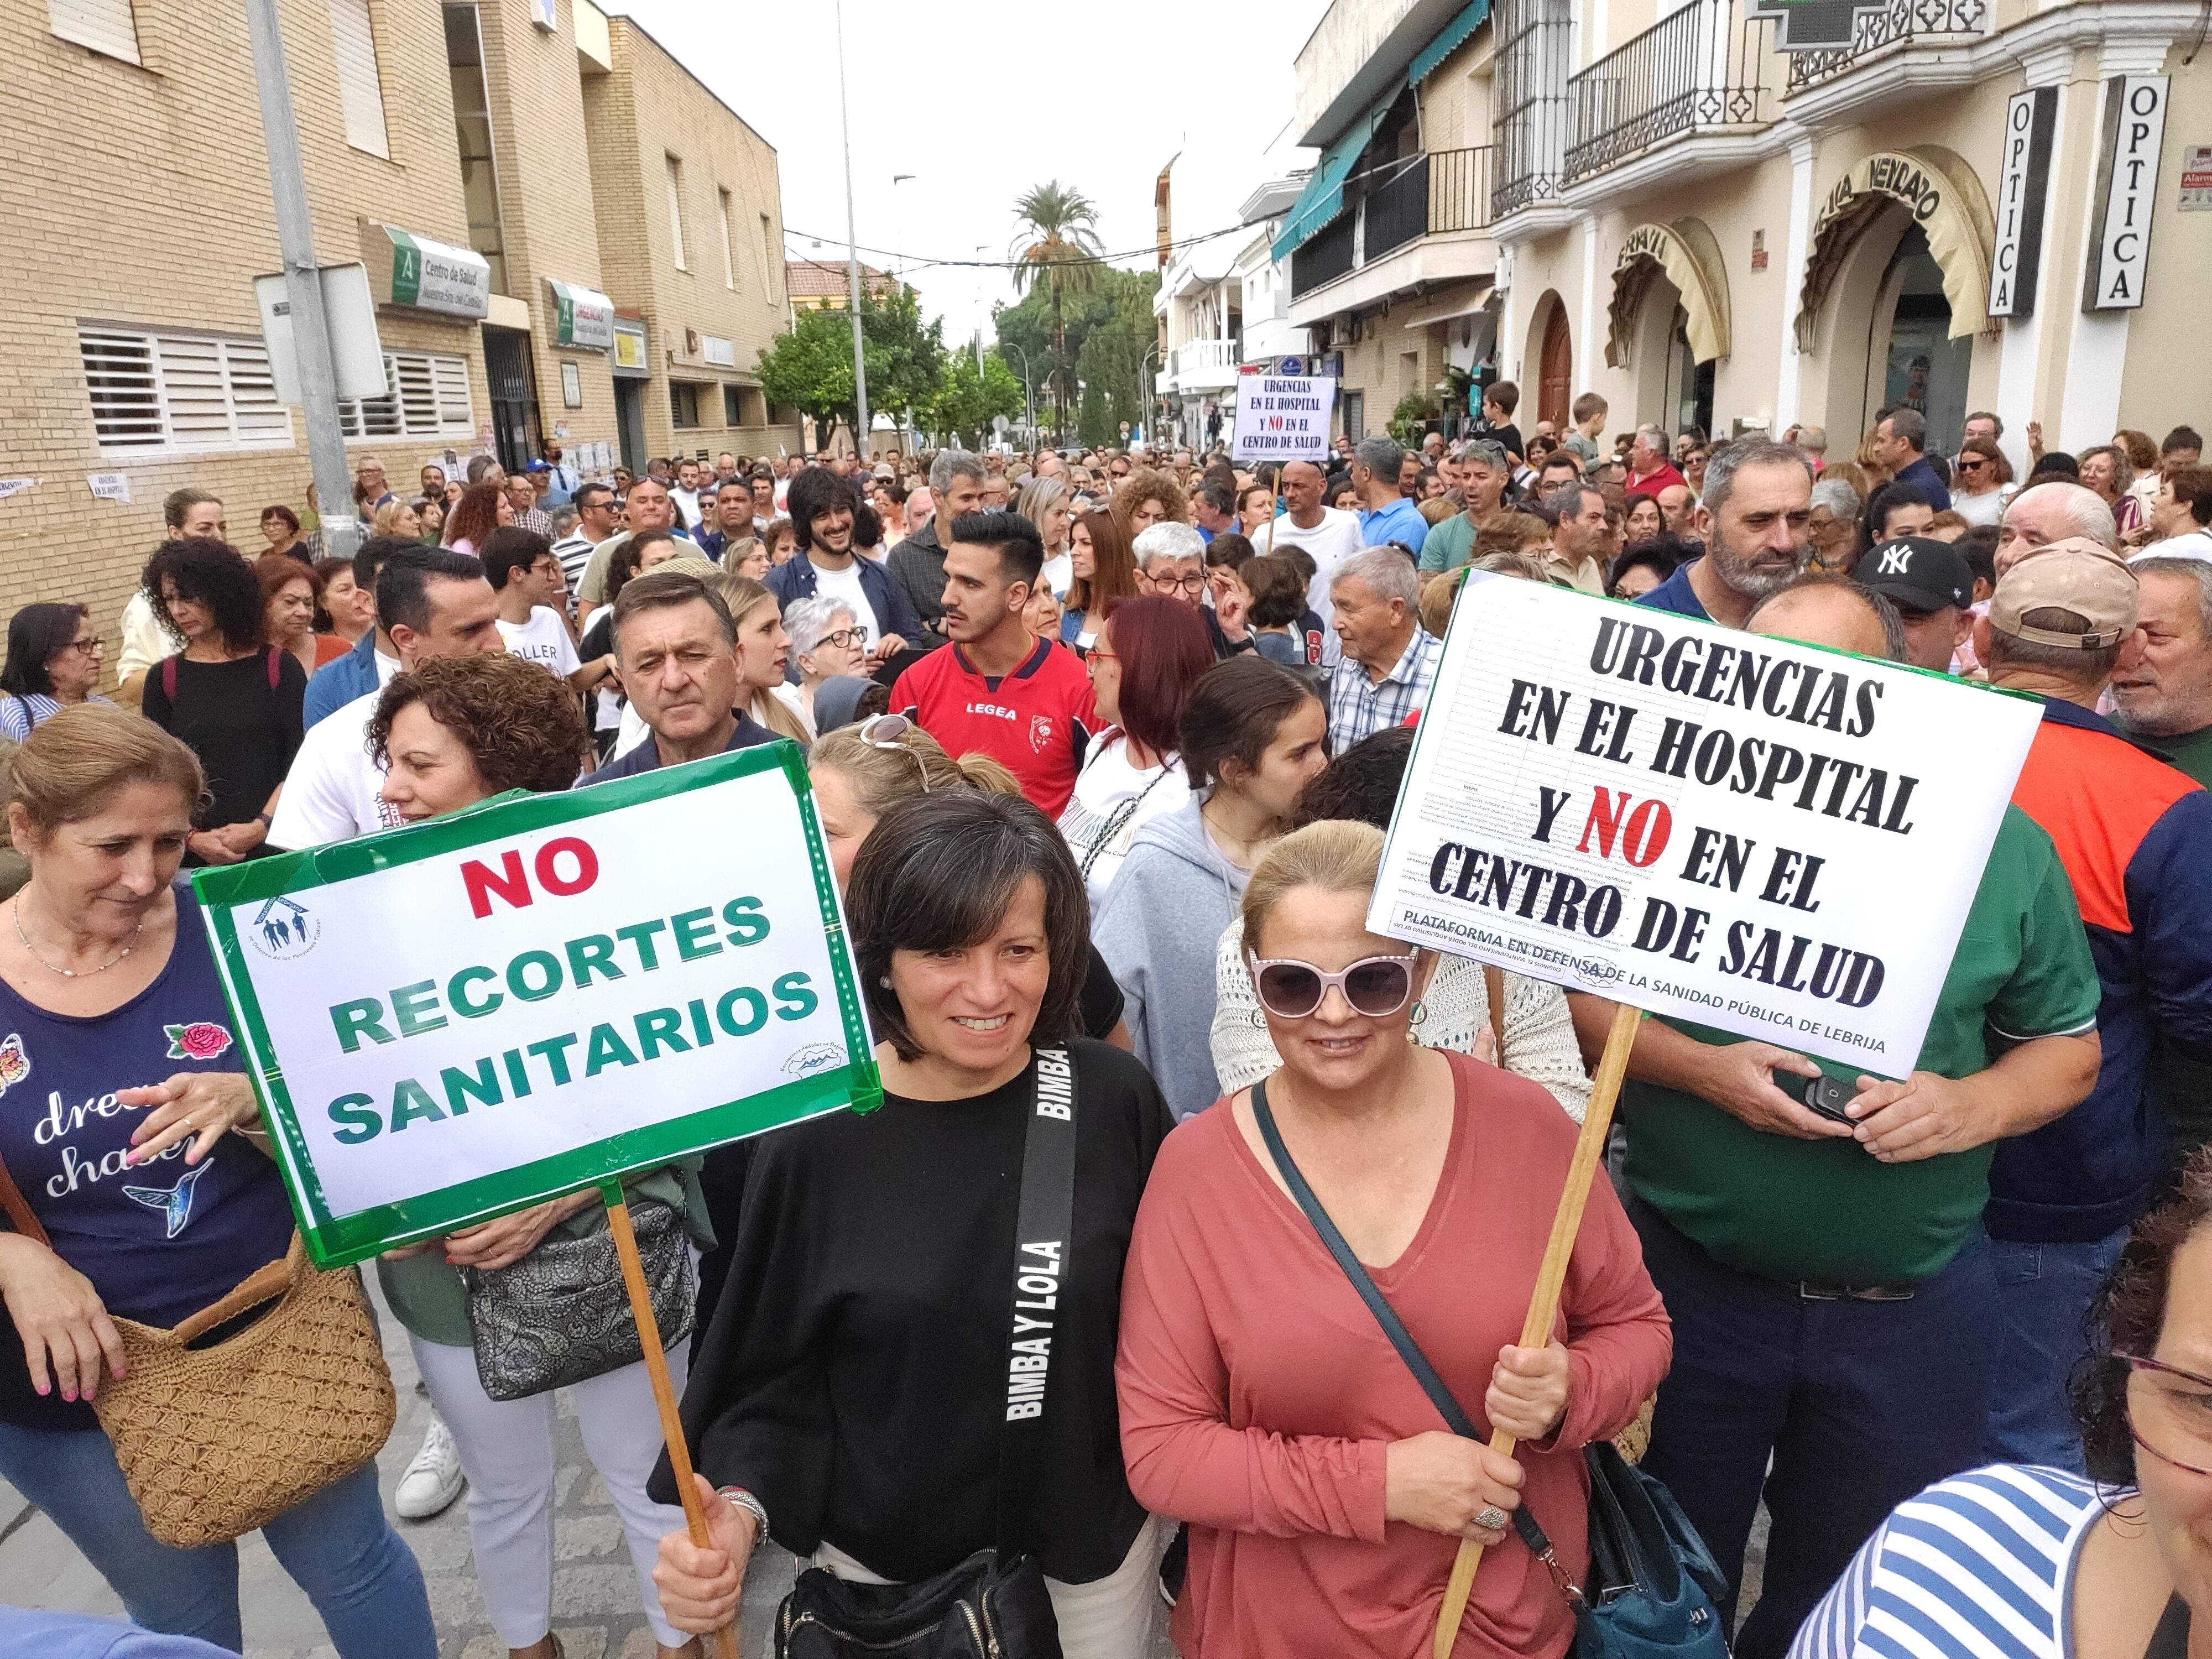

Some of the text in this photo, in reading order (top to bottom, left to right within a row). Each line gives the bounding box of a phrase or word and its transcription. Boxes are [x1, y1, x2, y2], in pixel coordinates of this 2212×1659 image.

[1996, 103, 2030, 307] OPTICA
[2109, 86, 2157, 299] OPTICA
[425, 259, 477, 285] Centro de Salud
[1243, 436, 1321, 448] CENTRO DE SALUD
[1250, 397, 1321, 410] EN EL HOSPITAL
[1260, 416, 1308, 431] Y NO EN EL
[1264, 380, 1311, 393] URGENCIAS
[1877, 536, 1913, 575] NY
[966, 703, 1016, 721] LEGEA
[1590, 616, 1884, 738] URGENCIAS
[1498, 679, 1572, 745] EN
[1575, 698, 1637, 764] EL
[1649, 718, 1919, 834] HOSPITAL
[460, 837, 599, 919] NO
[1531, 786, 1571, 843] Y
[1577, 786, 1672, 868] NO
[1679, 826, 1756, 892] EN
[1759, 847, 1825, 912] EL
[328, 895, 770, 1052] RECORTES
[1404, 910, 1503, 948] PLATAFORMA
[1507, 937, 1528, 955] EN
[1531, 946, 1599, 972] DEFENSA
[1605, 966, 1626, 982] DE
[1629, 973, 1647, 989] LA
[1652, 980, 1724, 1008] SANIDAD
[1727, 1000, 1793, 1028] PÚBLICA
[1799, 1020, 1821, 1035] DE
[1824, 1026, 1885, 1053] LEBRIJA
[1430, 842, 1622, 937] CENTRO
[1631, 896, 1710, 963] DE
[1718, 920, 1885, 1008] SALUD
[328, 972, 818, 1144] SANITARIOS
[1036, 1048, 1072, 1121] BIMBA
[1006, 1241, 1061, 1422] BIMBA Y LOLA
